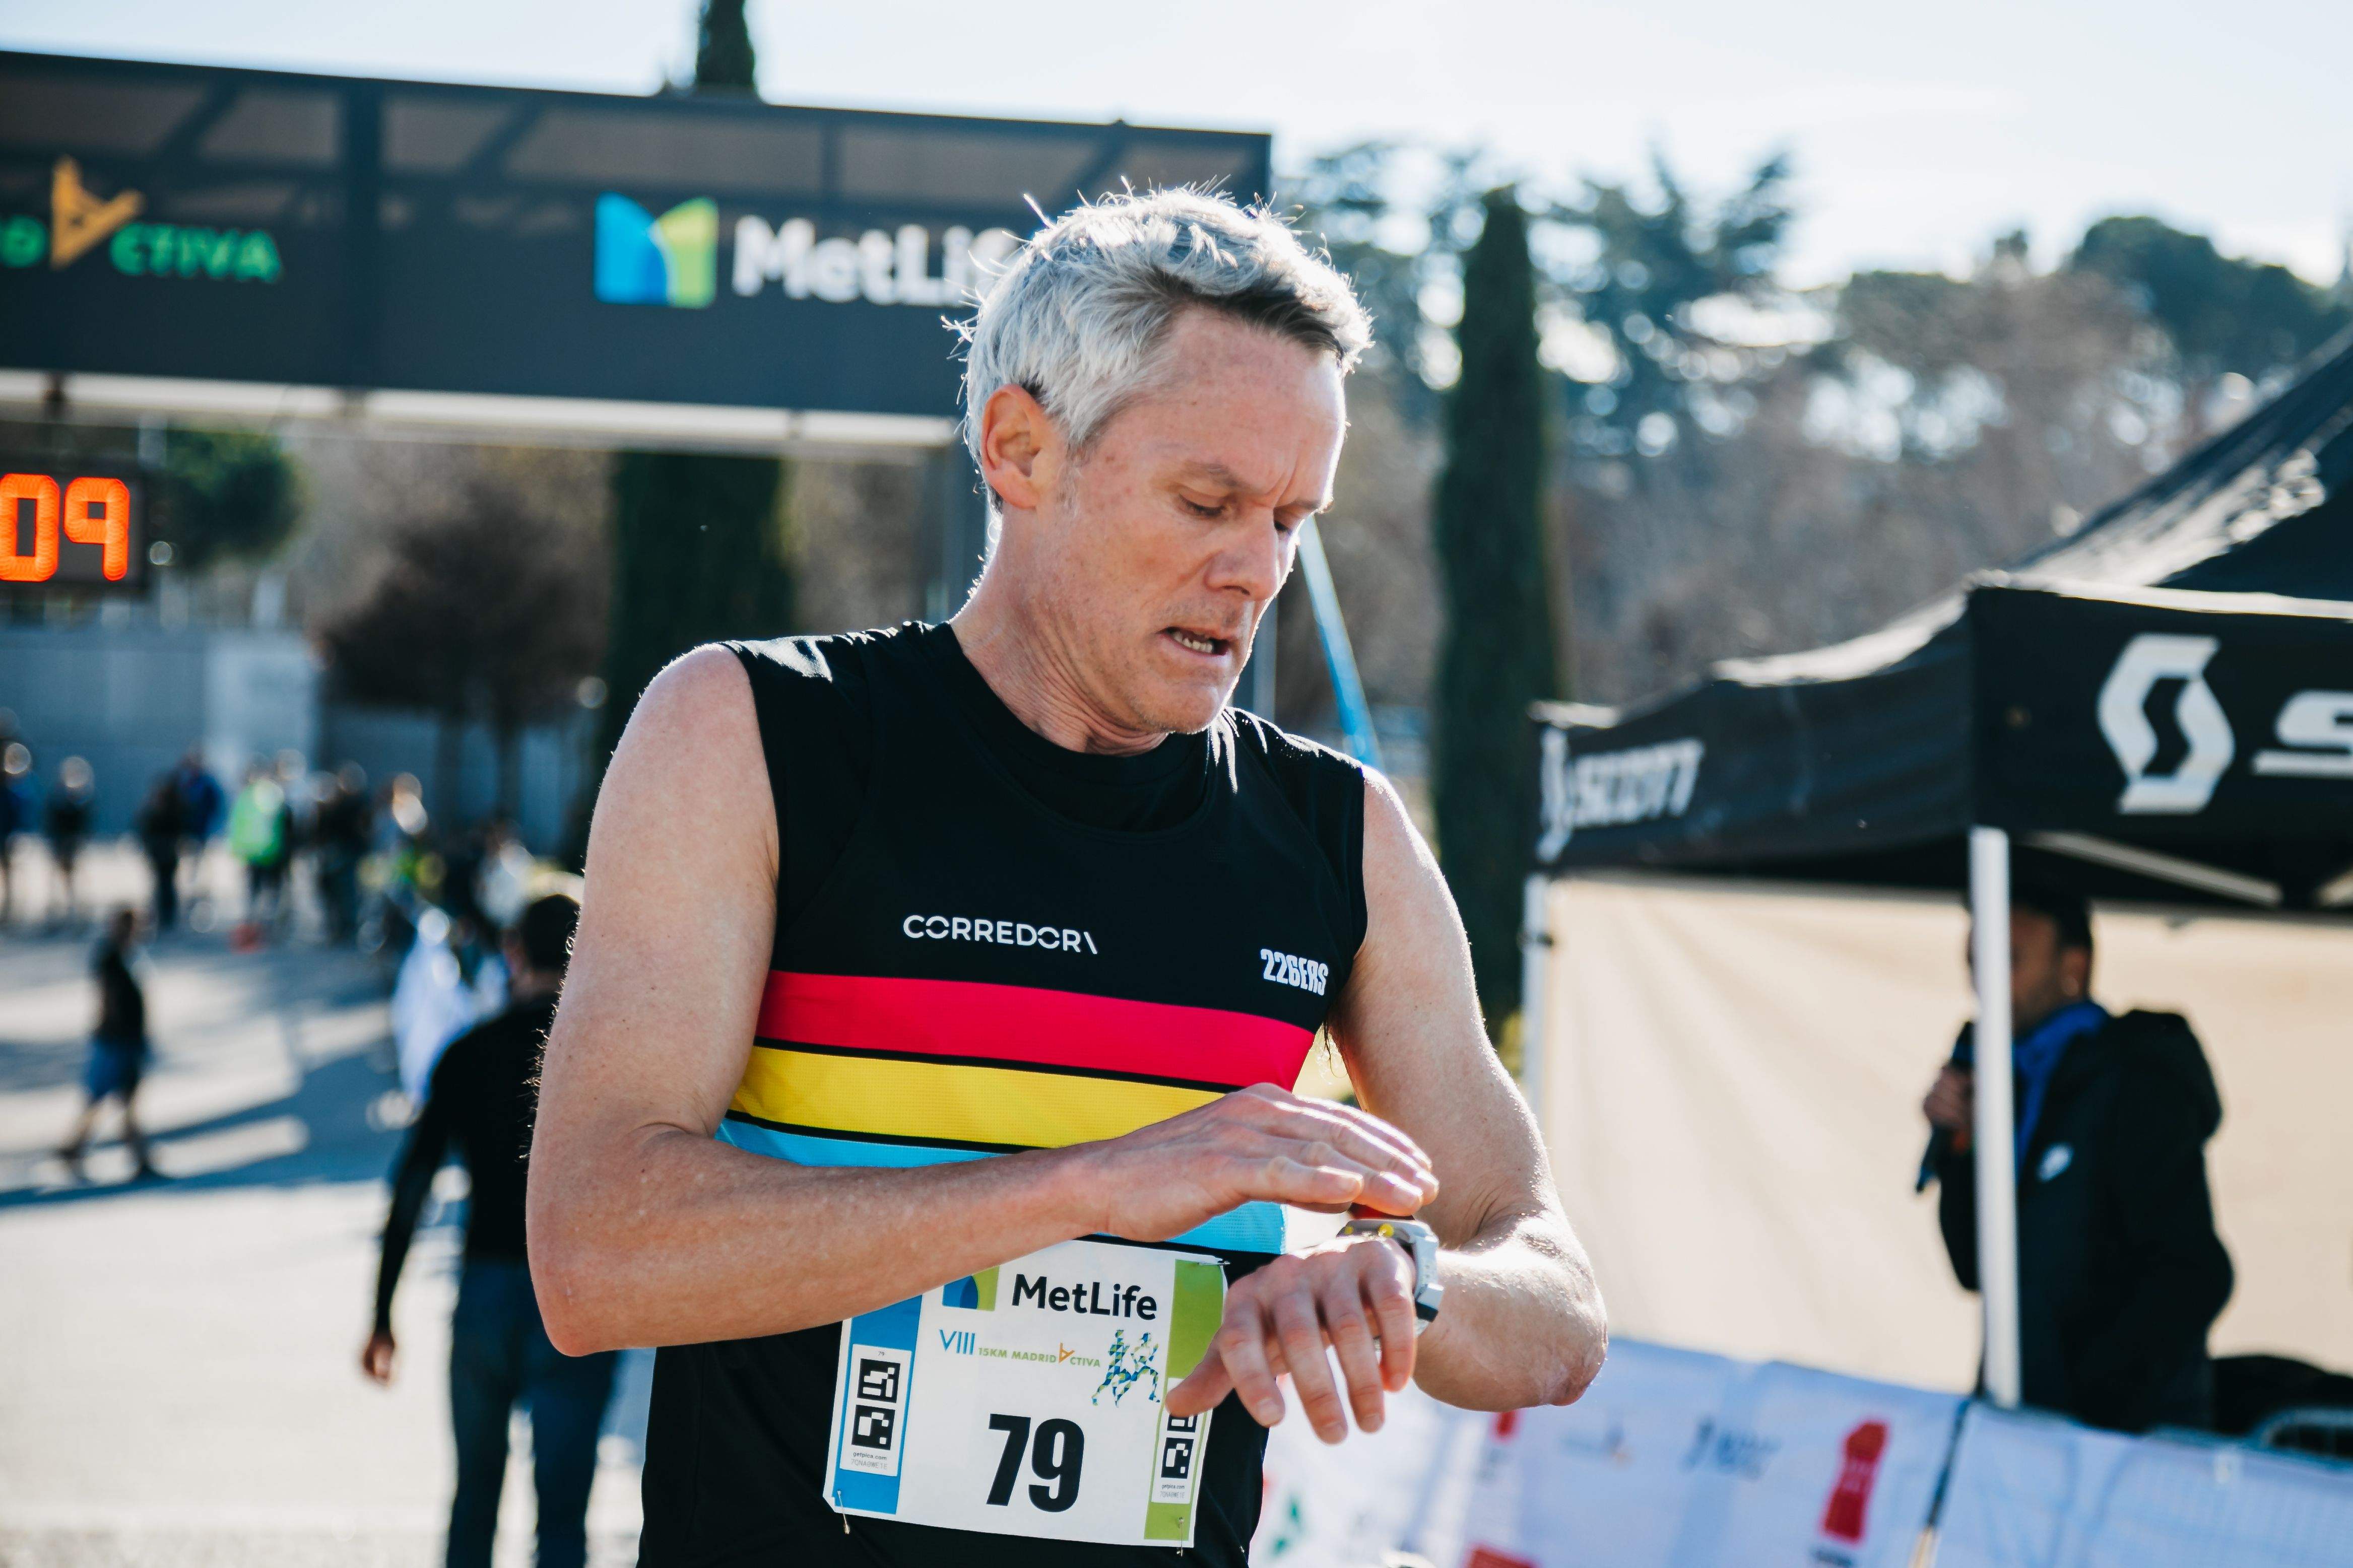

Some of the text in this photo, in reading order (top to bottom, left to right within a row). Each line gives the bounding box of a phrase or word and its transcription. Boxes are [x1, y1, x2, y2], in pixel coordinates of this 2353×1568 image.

[732, 215, 1020, 306] MetLif
[0, 472, 130, 581] 09
[1260, 948, 1329, 996] 226ERS
[1011, 1273, 1157, 1320] MetLife
[939, 1329, 975, 1355] VIII
[978, 1347, 1007, 1358] 15KM
[853, 1452, 887, 1461] getpica.com
[986, 1413, 1085, 1513] 79
